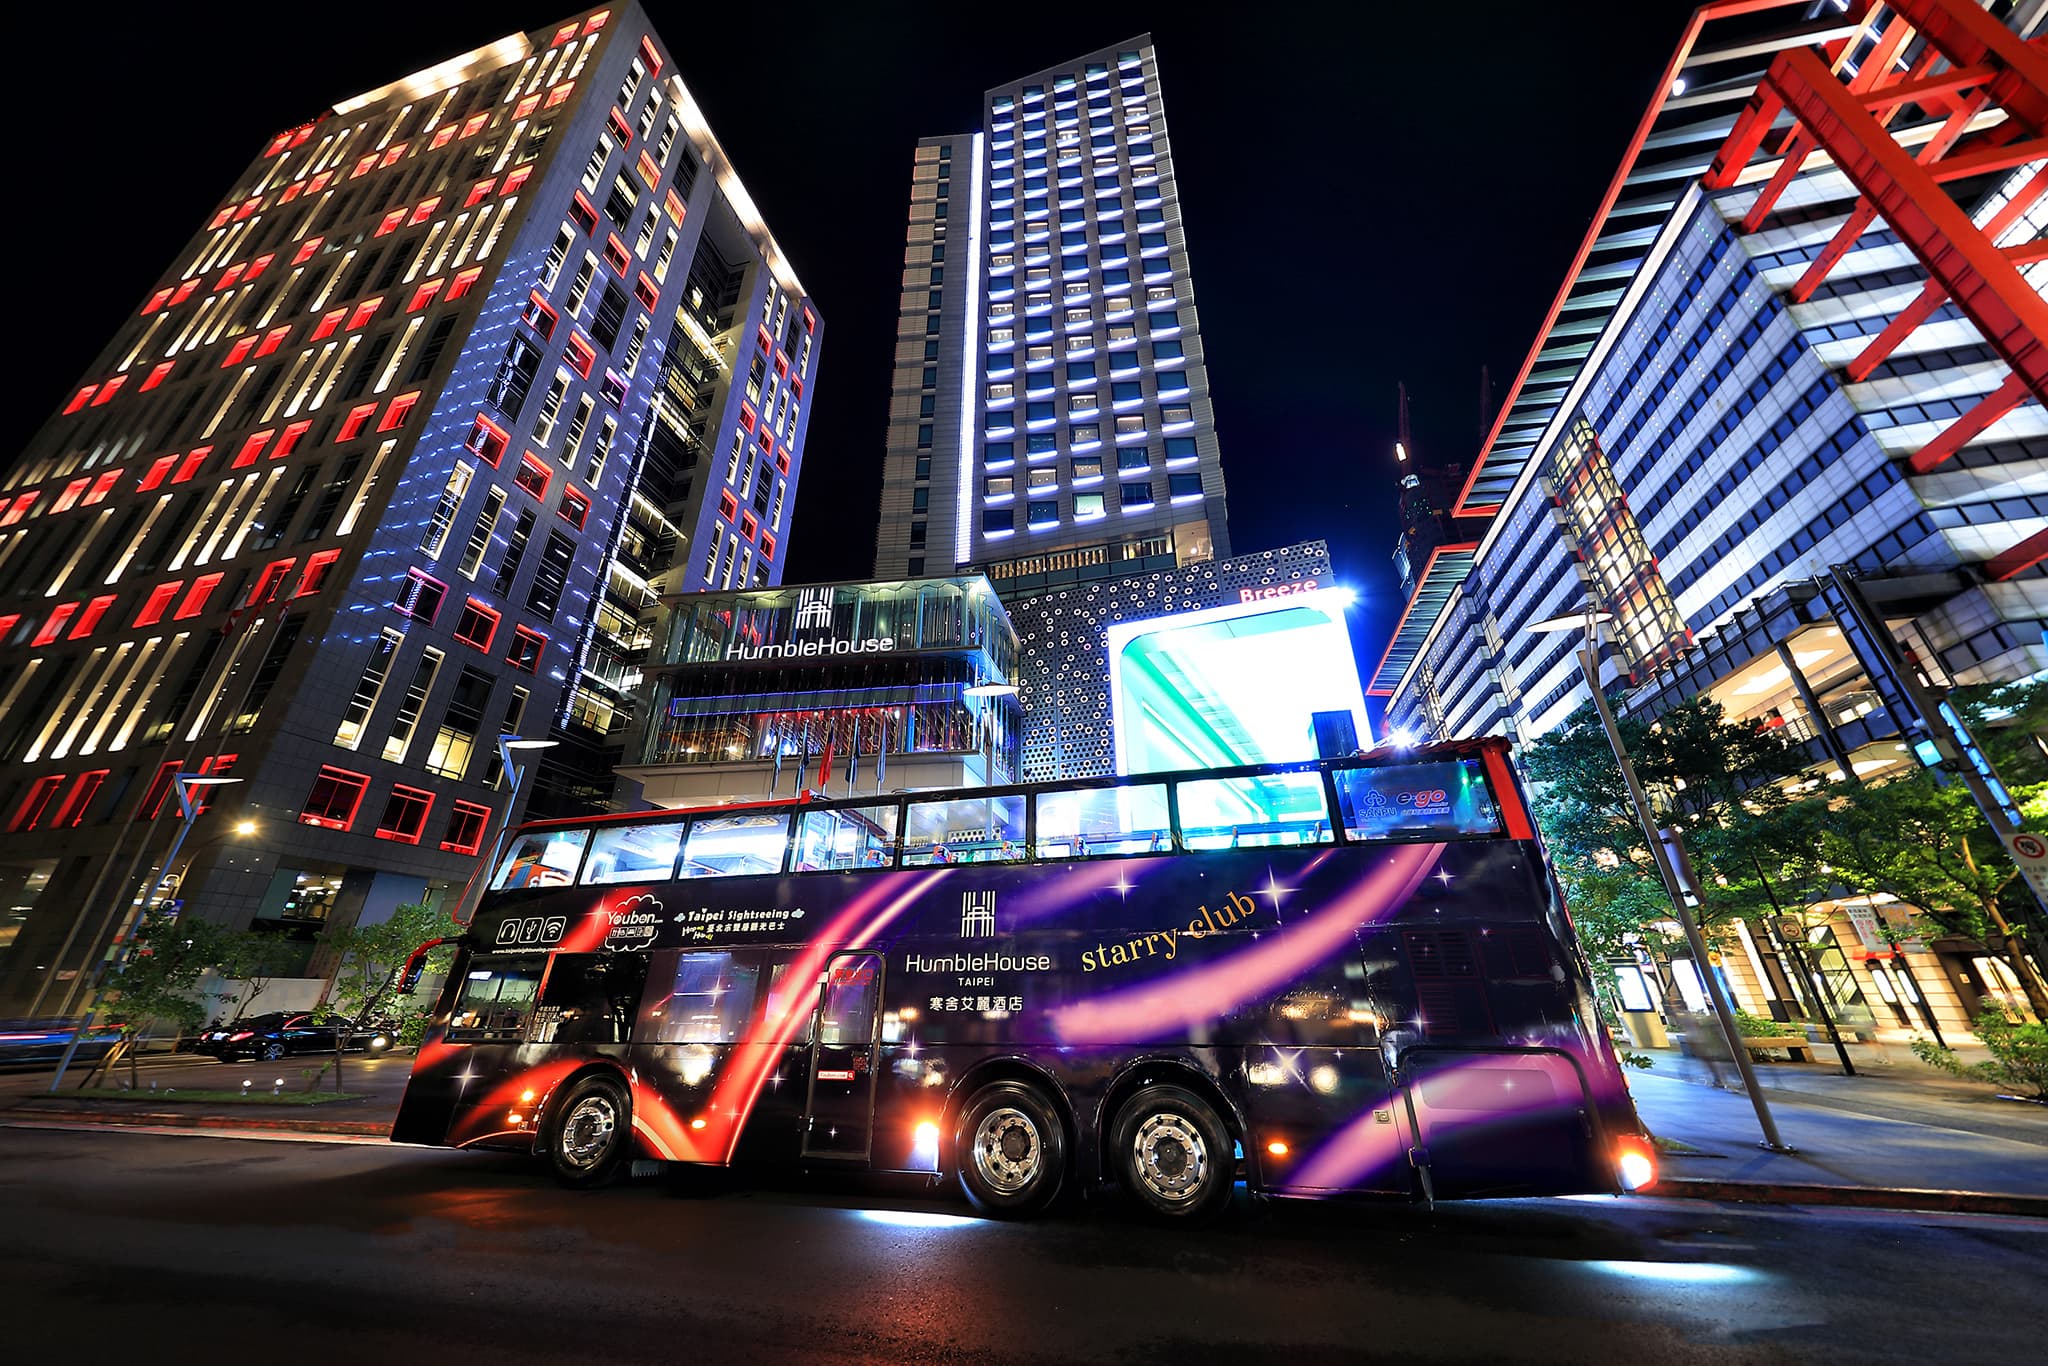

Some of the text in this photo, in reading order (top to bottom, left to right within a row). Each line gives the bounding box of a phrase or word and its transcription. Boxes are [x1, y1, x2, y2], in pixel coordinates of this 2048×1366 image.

[1239, 579, 1318, 604] Breeze
[725, 636, 894, 661] HumbleHouse
[1358, 806, 1398, 818] SANPU
[688, 907, 790, 922] Taipei Sightseeing
[1081, 890, 1257, 973] starry club
[904, 952, 1051, 974] HumbleHouse
[957, 977, 995, 987] TAIPEI
[929, 996, 1024, 1012] 寒舍艾麗酒店
